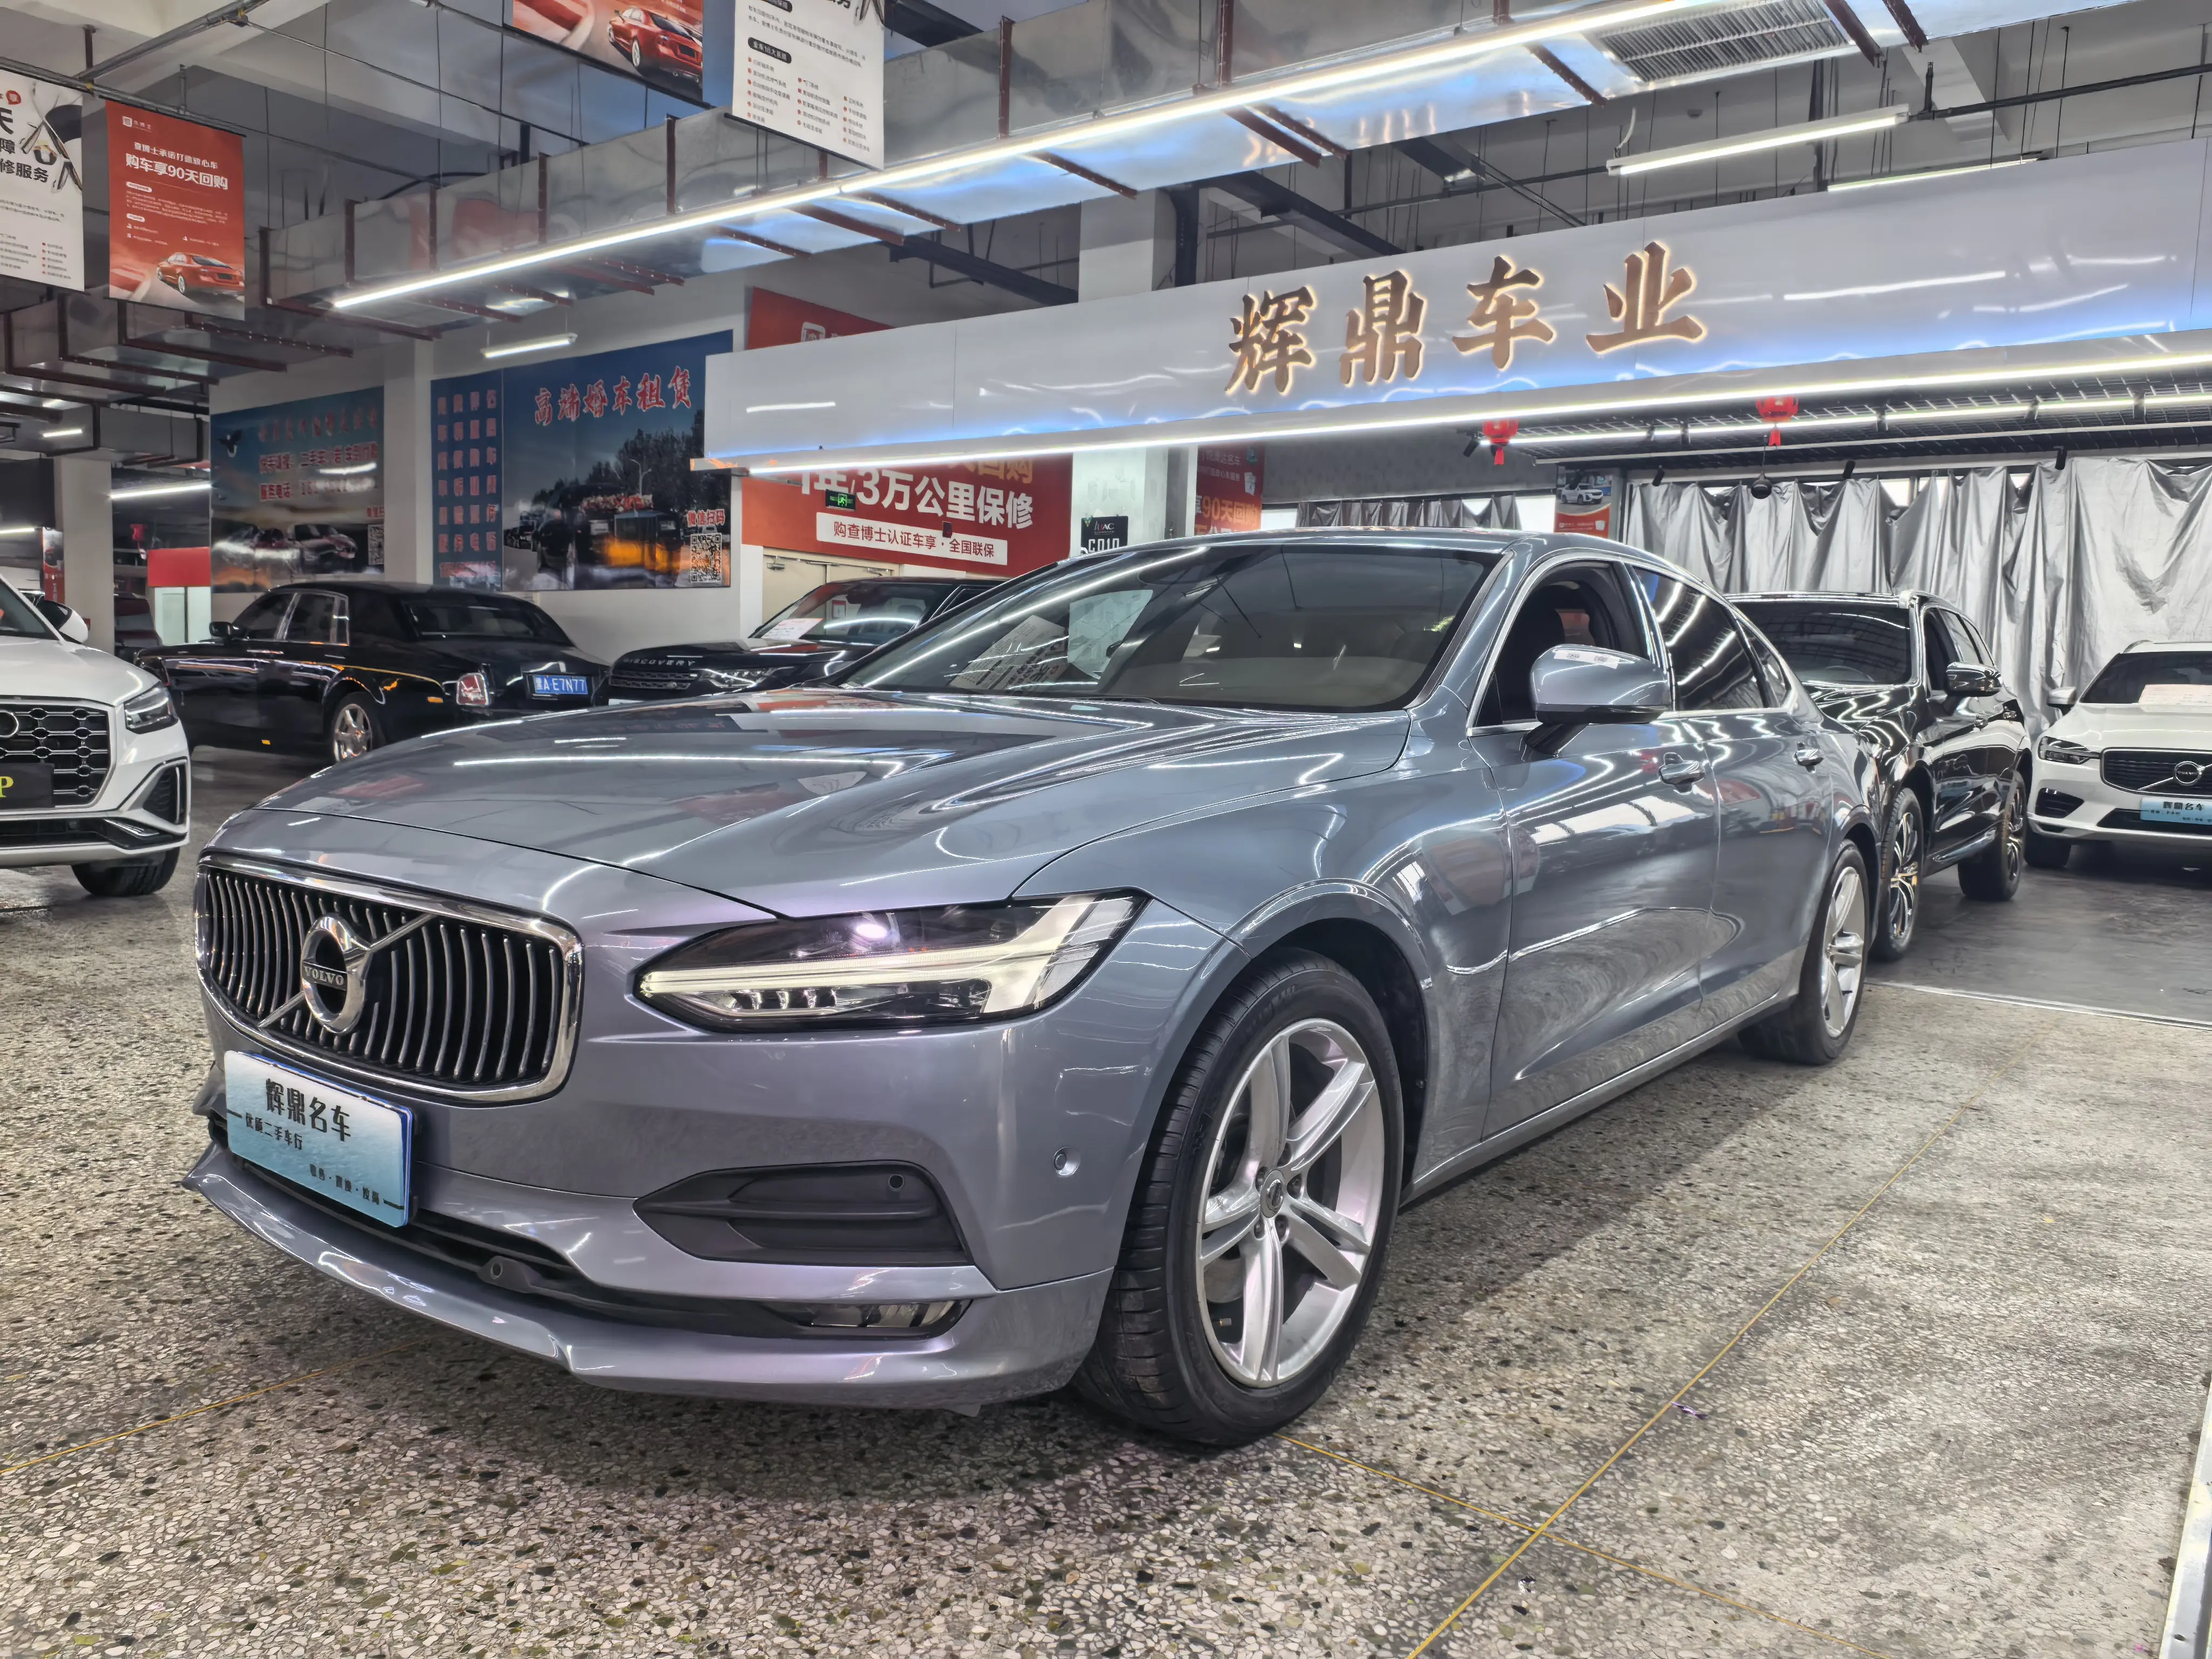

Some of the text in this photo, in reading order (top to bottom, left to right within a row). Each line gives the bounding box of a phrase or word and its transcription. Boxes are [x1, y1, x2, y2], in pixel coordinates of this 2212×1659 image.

[126, 153, 228, 190] 购车享90天回购
[1224, 241, 1705, 394] 辉鼎车业
[535, 365, 691, 427] 高端婚车租赁
[623, 658, 696, 667] DISCOVERY
[304, 966, 344, 986] VOLVO
[266, 1078, 350, 1142] 辉鼎名车
